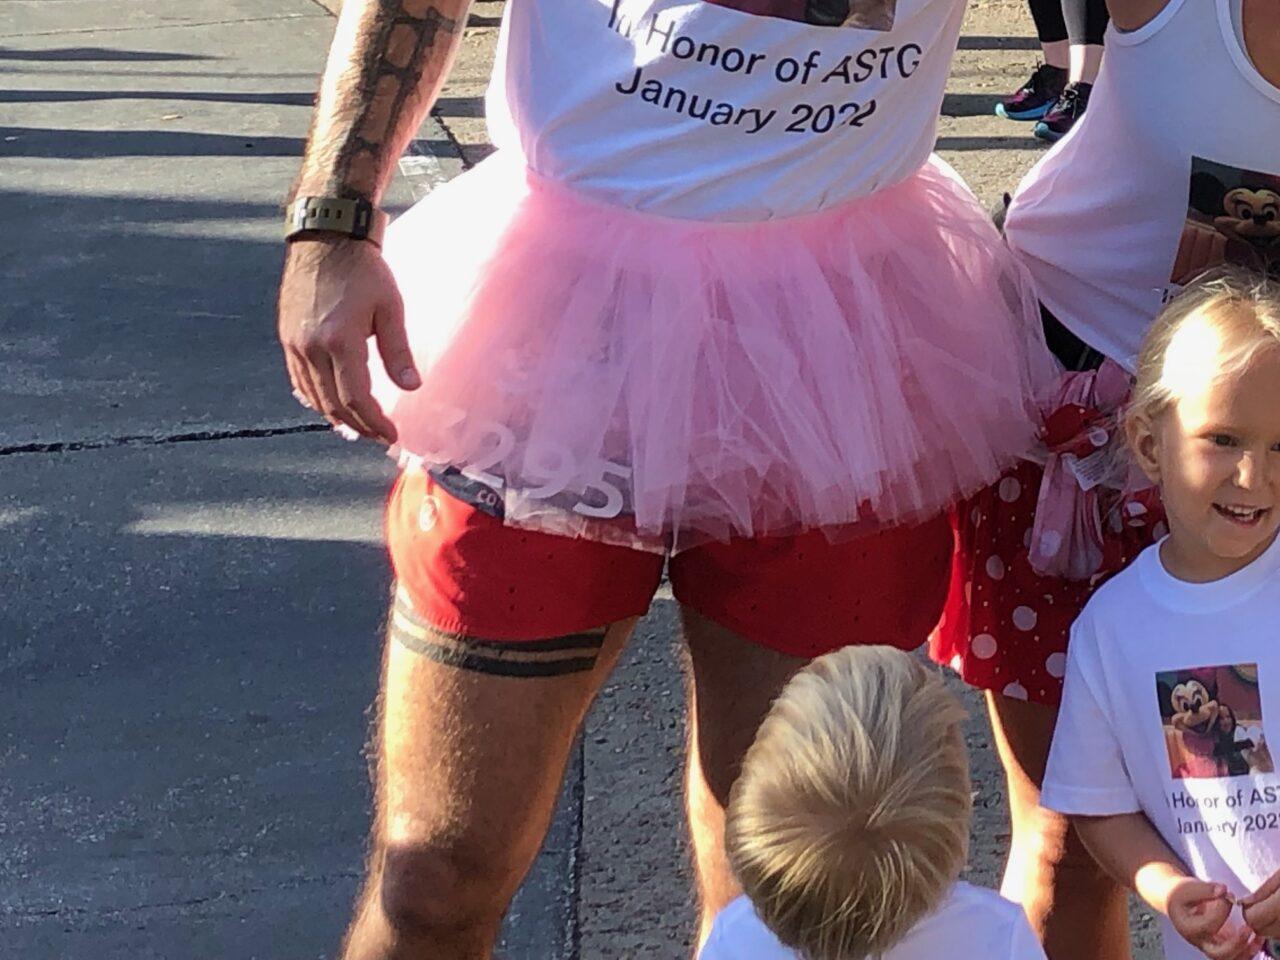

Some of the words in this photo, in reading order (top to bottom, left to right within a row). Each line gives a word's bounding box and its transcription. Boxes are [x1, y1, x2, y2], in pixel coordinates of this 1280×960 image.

[646, 13, 766, 75] Honor
[775, 50, 821, 85] of
[821, 43, 923, 84] ASTG
[615, 67, 777, 135] January
[1226, 789, 1243, 808] of
